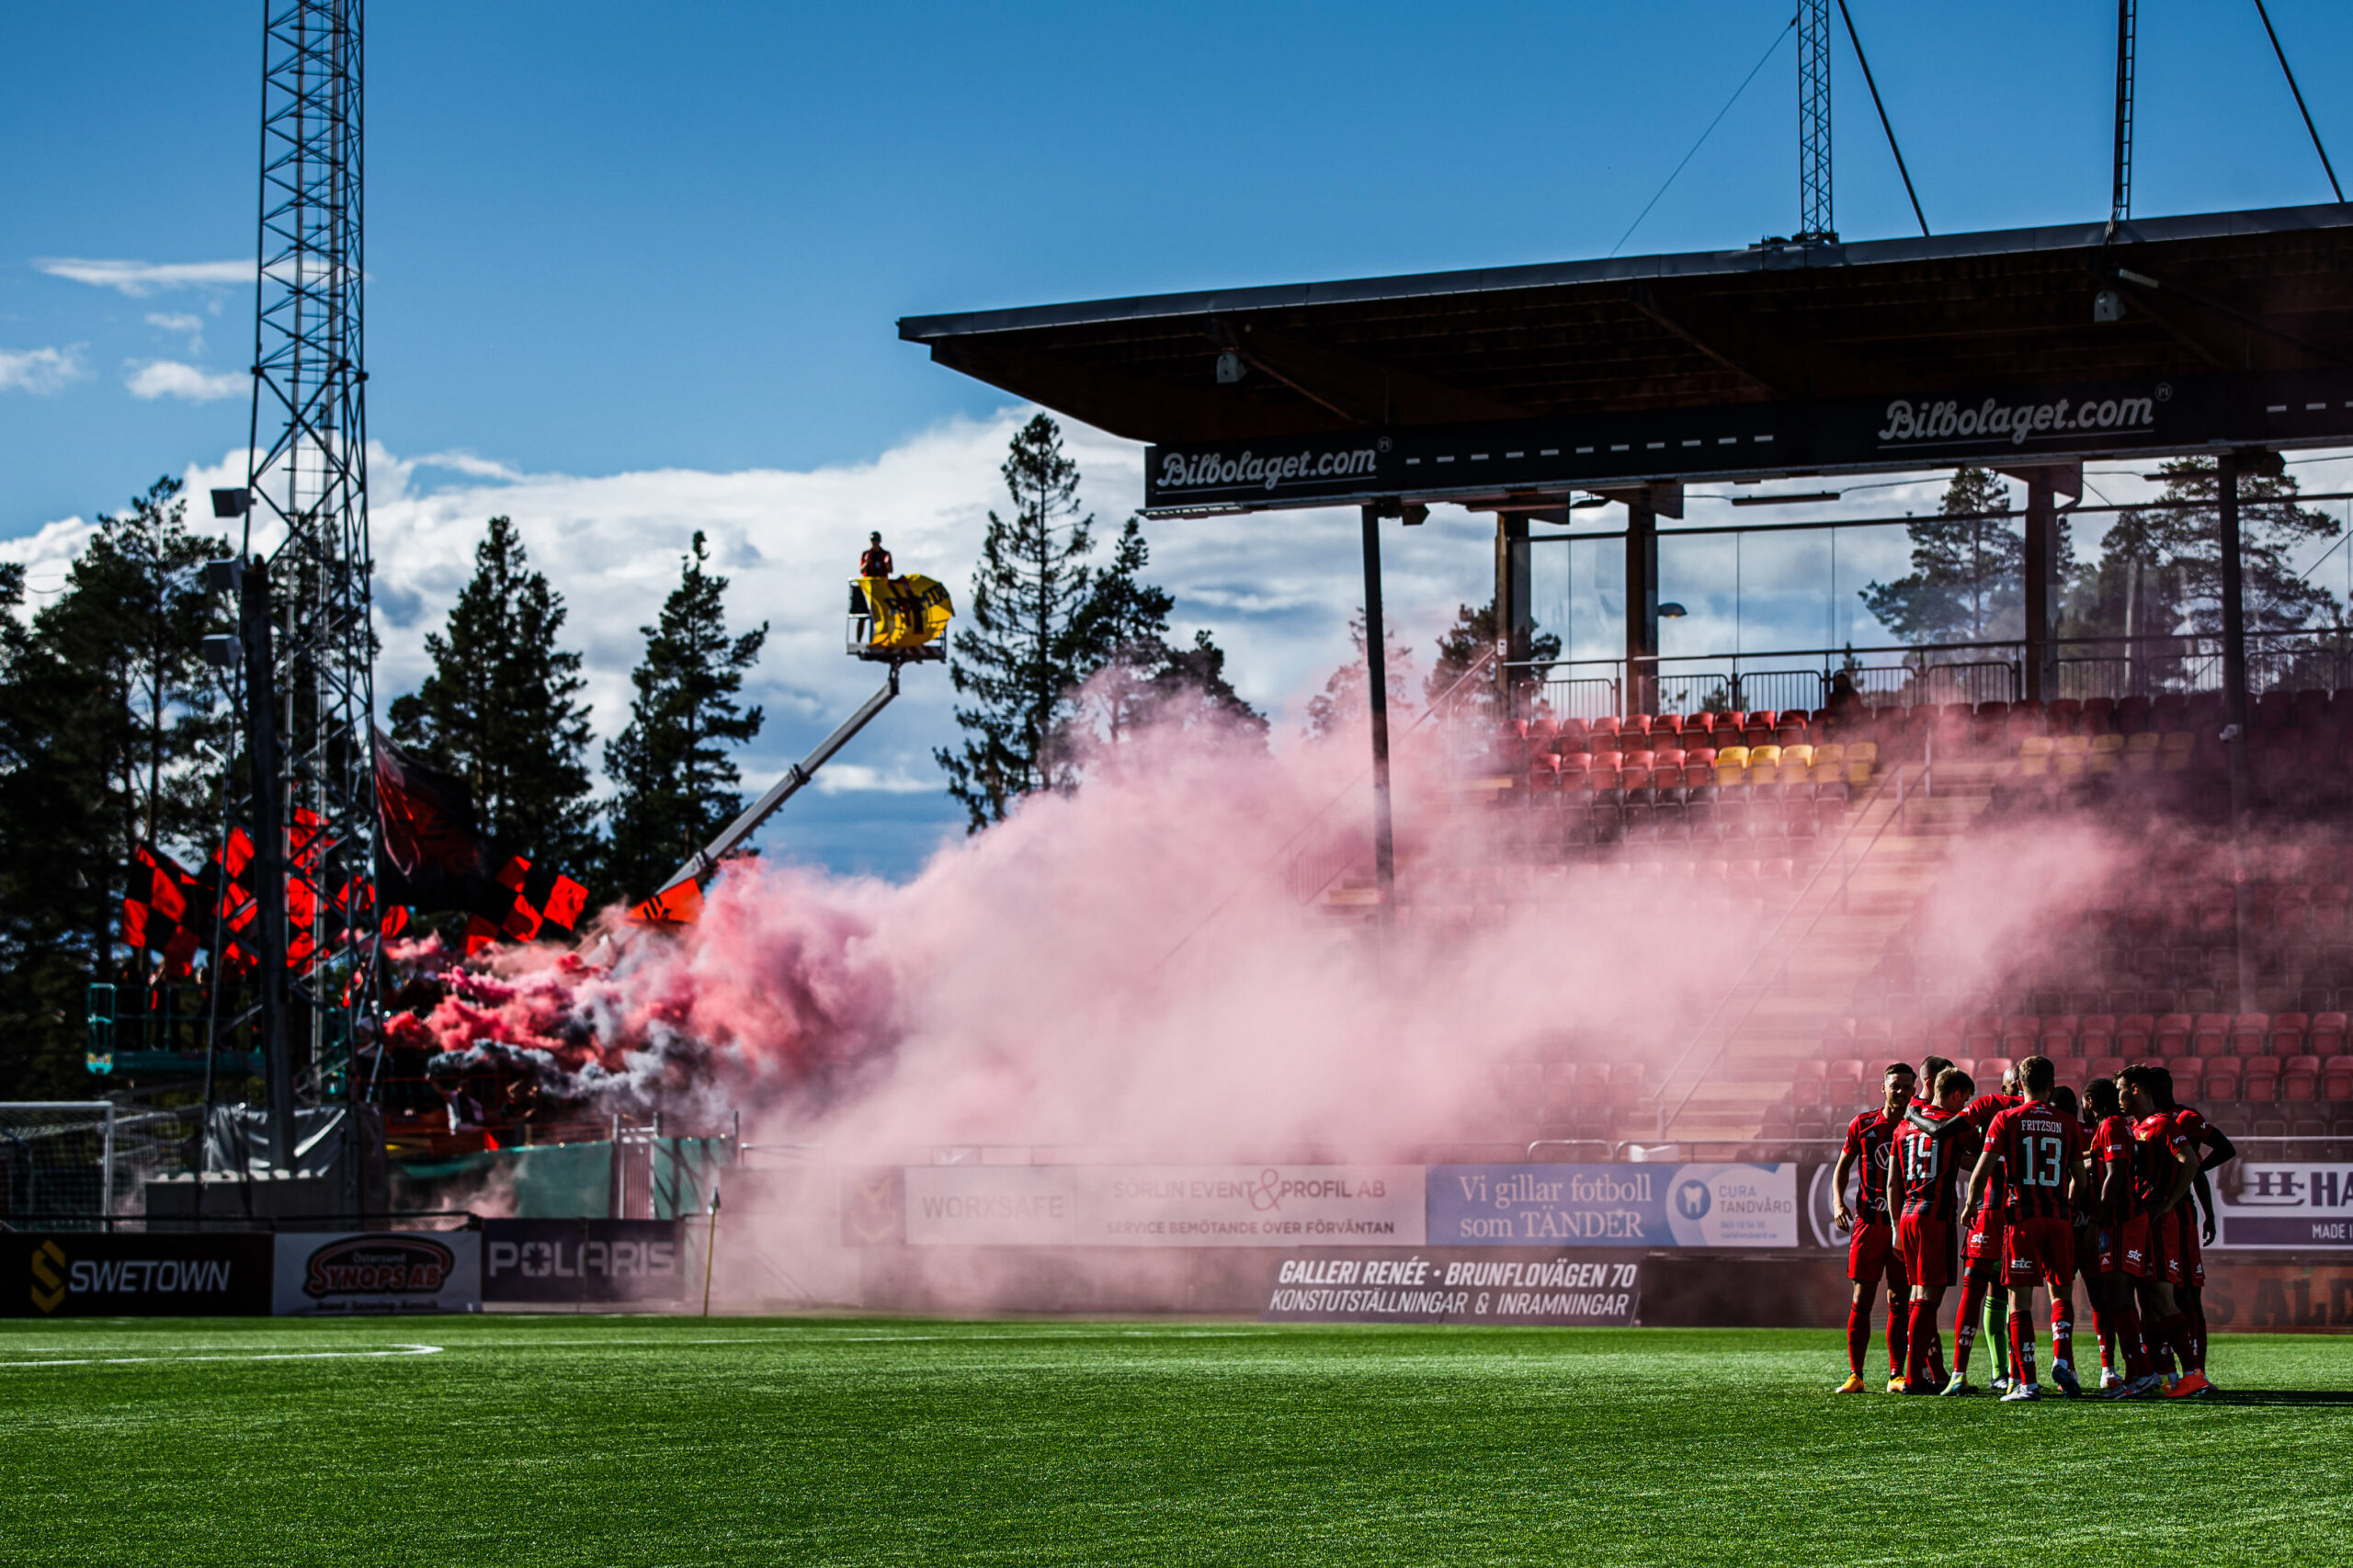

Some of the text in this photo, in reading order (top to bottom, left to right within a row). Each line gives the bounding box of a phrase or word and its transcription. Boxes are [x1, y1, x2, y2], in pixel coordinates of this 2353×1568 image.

[1878, 397, 2154, 445] Bilbolaget.com
[1155, 449, 1377, 491] Bilbolaget.com
[2021, 1119, 2063, 1134] FRITZSON
[1905, 1133, 1939, 1181] 19
[2022, 1136, 2063, 1187] 13
[1357, 1180, 1386, 1199] AB
[1460, 1174, 1653, 1209] Vi gillar fotboll
[1719, 1185, 1756, 1198] CURA
[1719, 1197, 1792, 1214] TANDVÅRD
[923, 1194, 1065, 1221] WORXSAFE
[1460, 1205, 1645, 1238] som TÄNDER
[1107, 1218, 1395, 1234] SERVICE BEMÖTANDE ÖVER FÖRVÄNTAN
[2312, 1223, 2347, 1239] MADE
[488, 1240, 675, 1277] POLARIS
[1278, 1256, 1638, 1289] GALLERI RENÉE BRUNFLOVÄGEN 70
[69, 1258, 231, 1293] SWETOWN
[309, 1262, 441, 1294] SYNOPS AB
[1268, 1287, 1630, 1316] KONSTUTSTÄLLNINGAR & INRAMNINGAR
